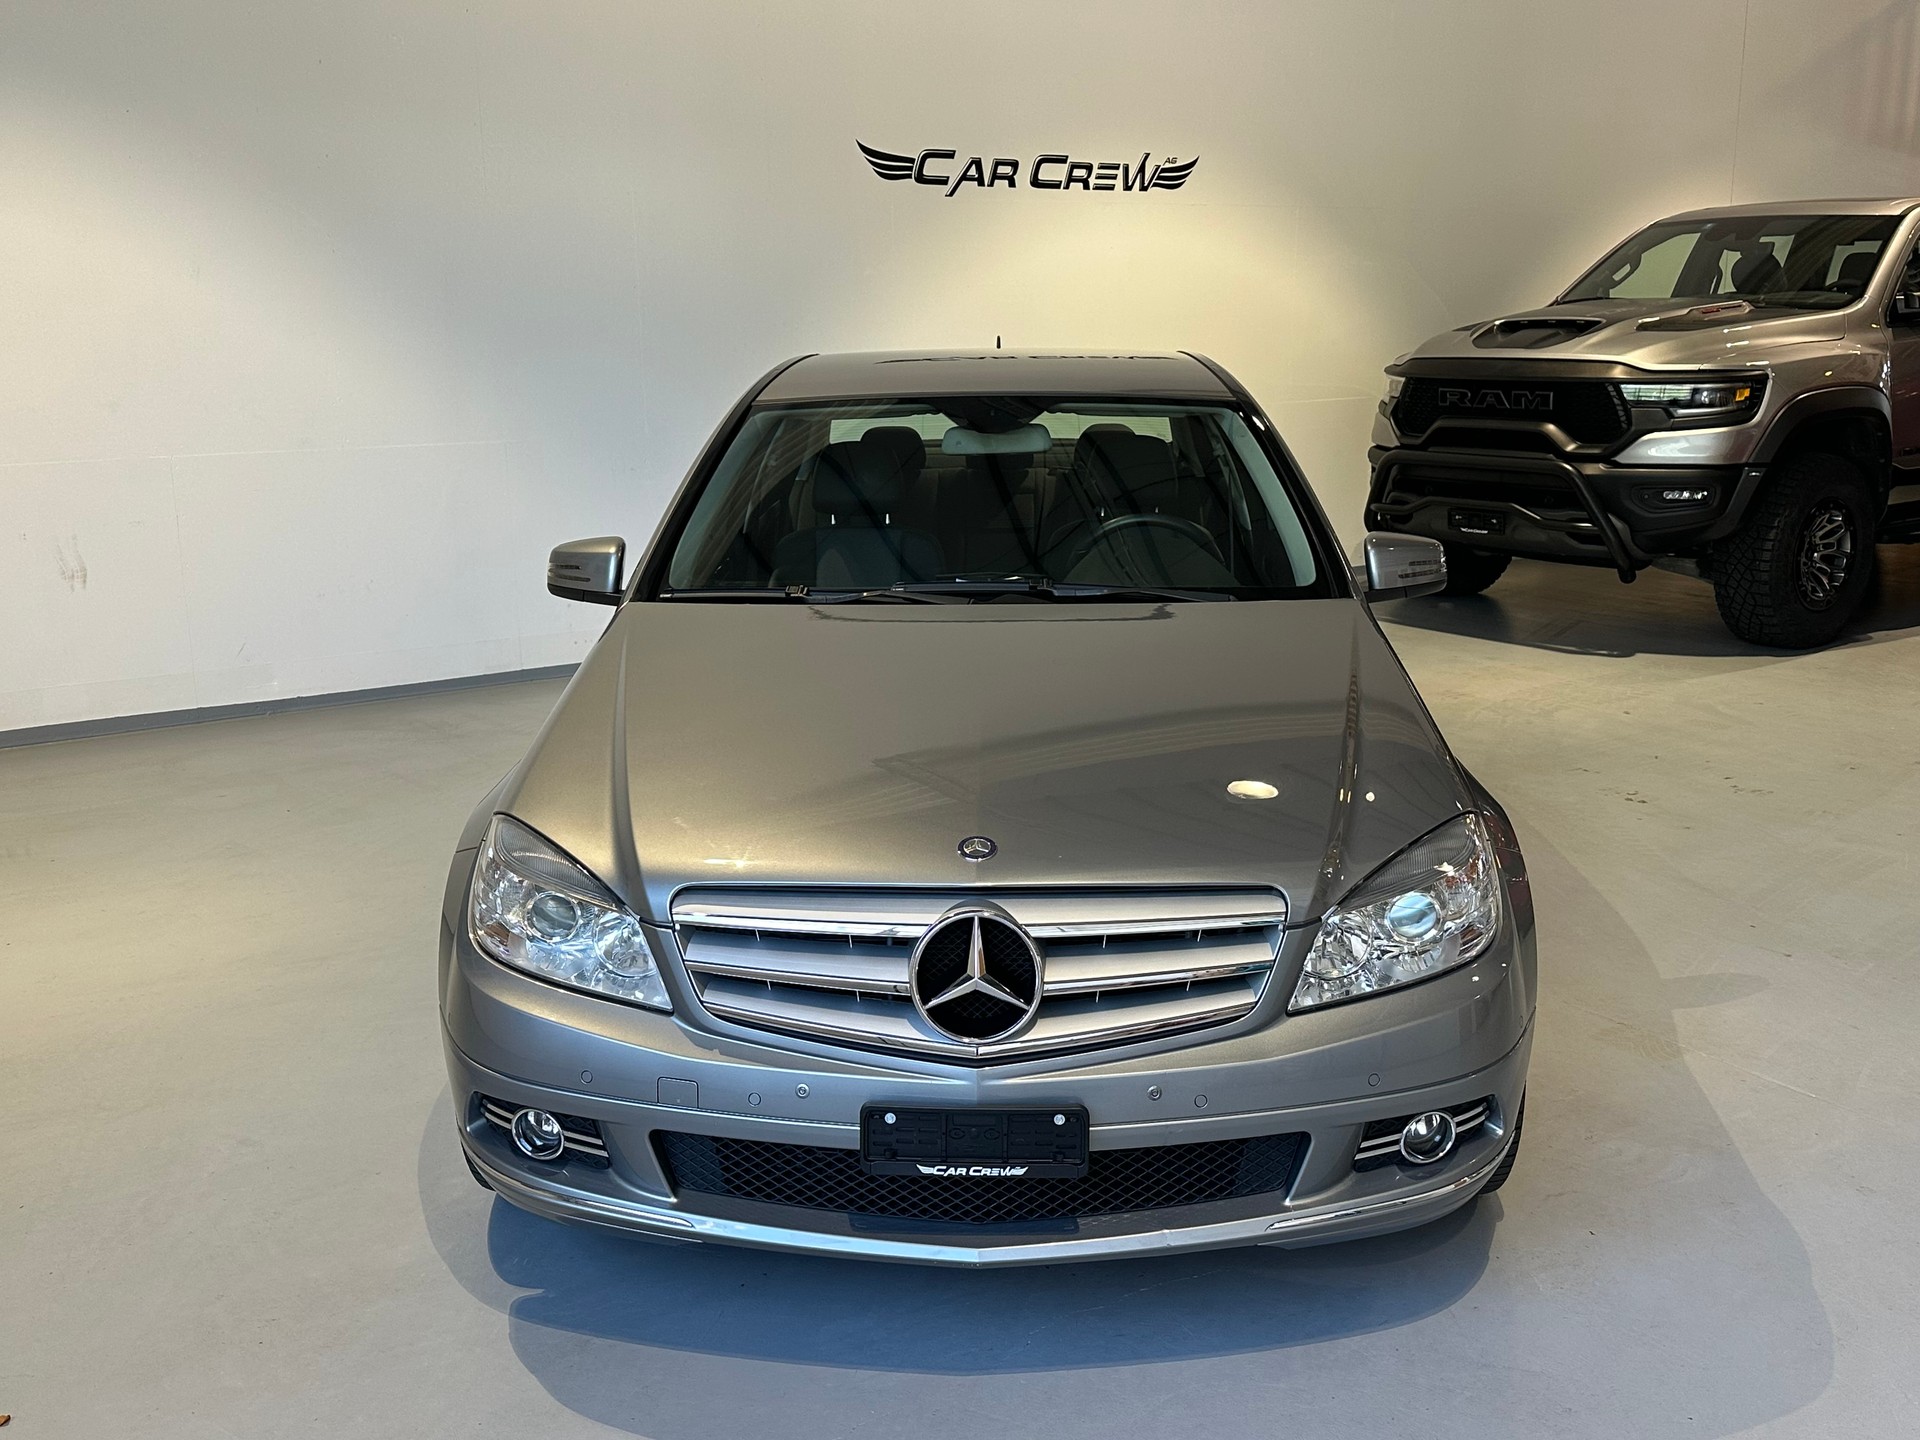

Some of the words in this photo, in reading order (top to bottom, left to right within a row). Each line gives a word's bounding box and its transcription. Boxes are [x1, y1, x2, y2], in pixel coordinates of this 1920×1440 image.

[913, 148, 1020, 198] CAR
[1029, 152, 1162, 192] CREW
[1438, 387, 1553, 410] RAM
[933, 1165, 967, 1177] CAR
